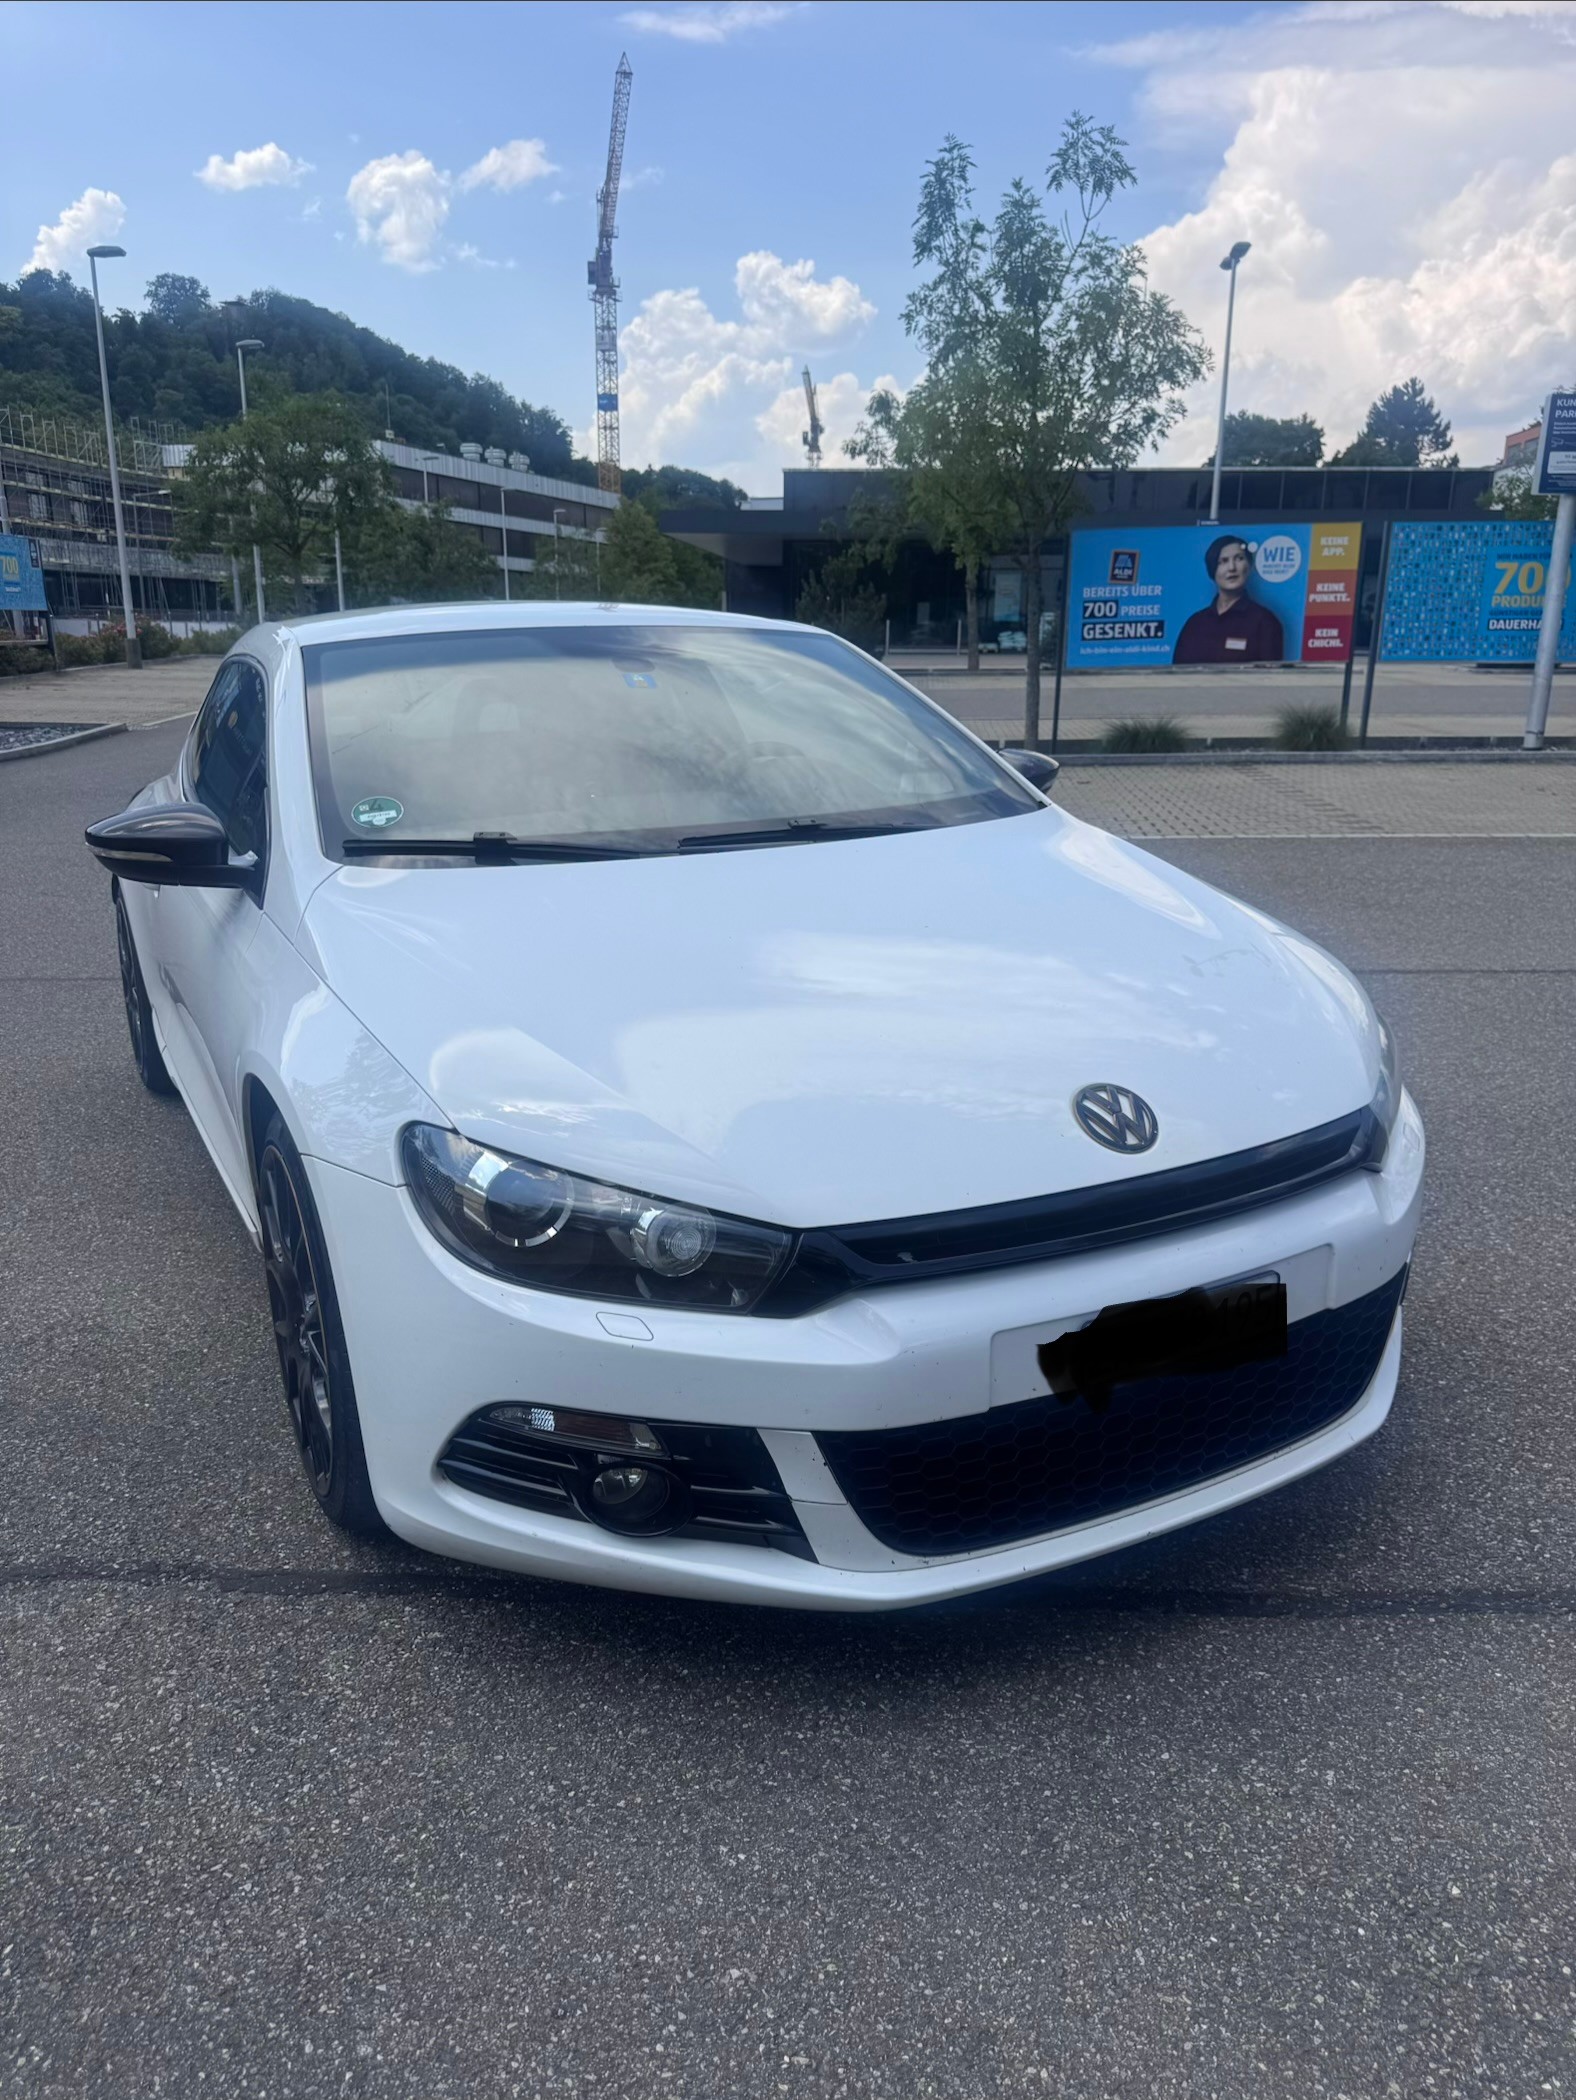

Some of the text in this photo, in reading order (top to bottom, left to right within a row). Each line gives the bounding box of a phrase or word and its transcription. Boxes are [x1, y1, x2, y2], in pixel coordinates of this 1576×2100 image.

[1321, 536, 1349, 545] KEINE
[1263, 546, 1296, 562] WIE
[1322, 547, 1344, 556] APP.
[1113, 568, 1133, 576] ALDI
[1083, 583, 1162, 598] BEREITS ÜBER
[1316, 583, 1345, 592] KEINE
[1309, 593, 1351, 603] PUNKTE.
[1083, 601, 1160, 618] 700 PREISE
[1083, 622, 1163, 640] GESENKT.
[1315, 628, 1338, 637] KEIN
[1308, 639, 1344, 648] CHICHI.
